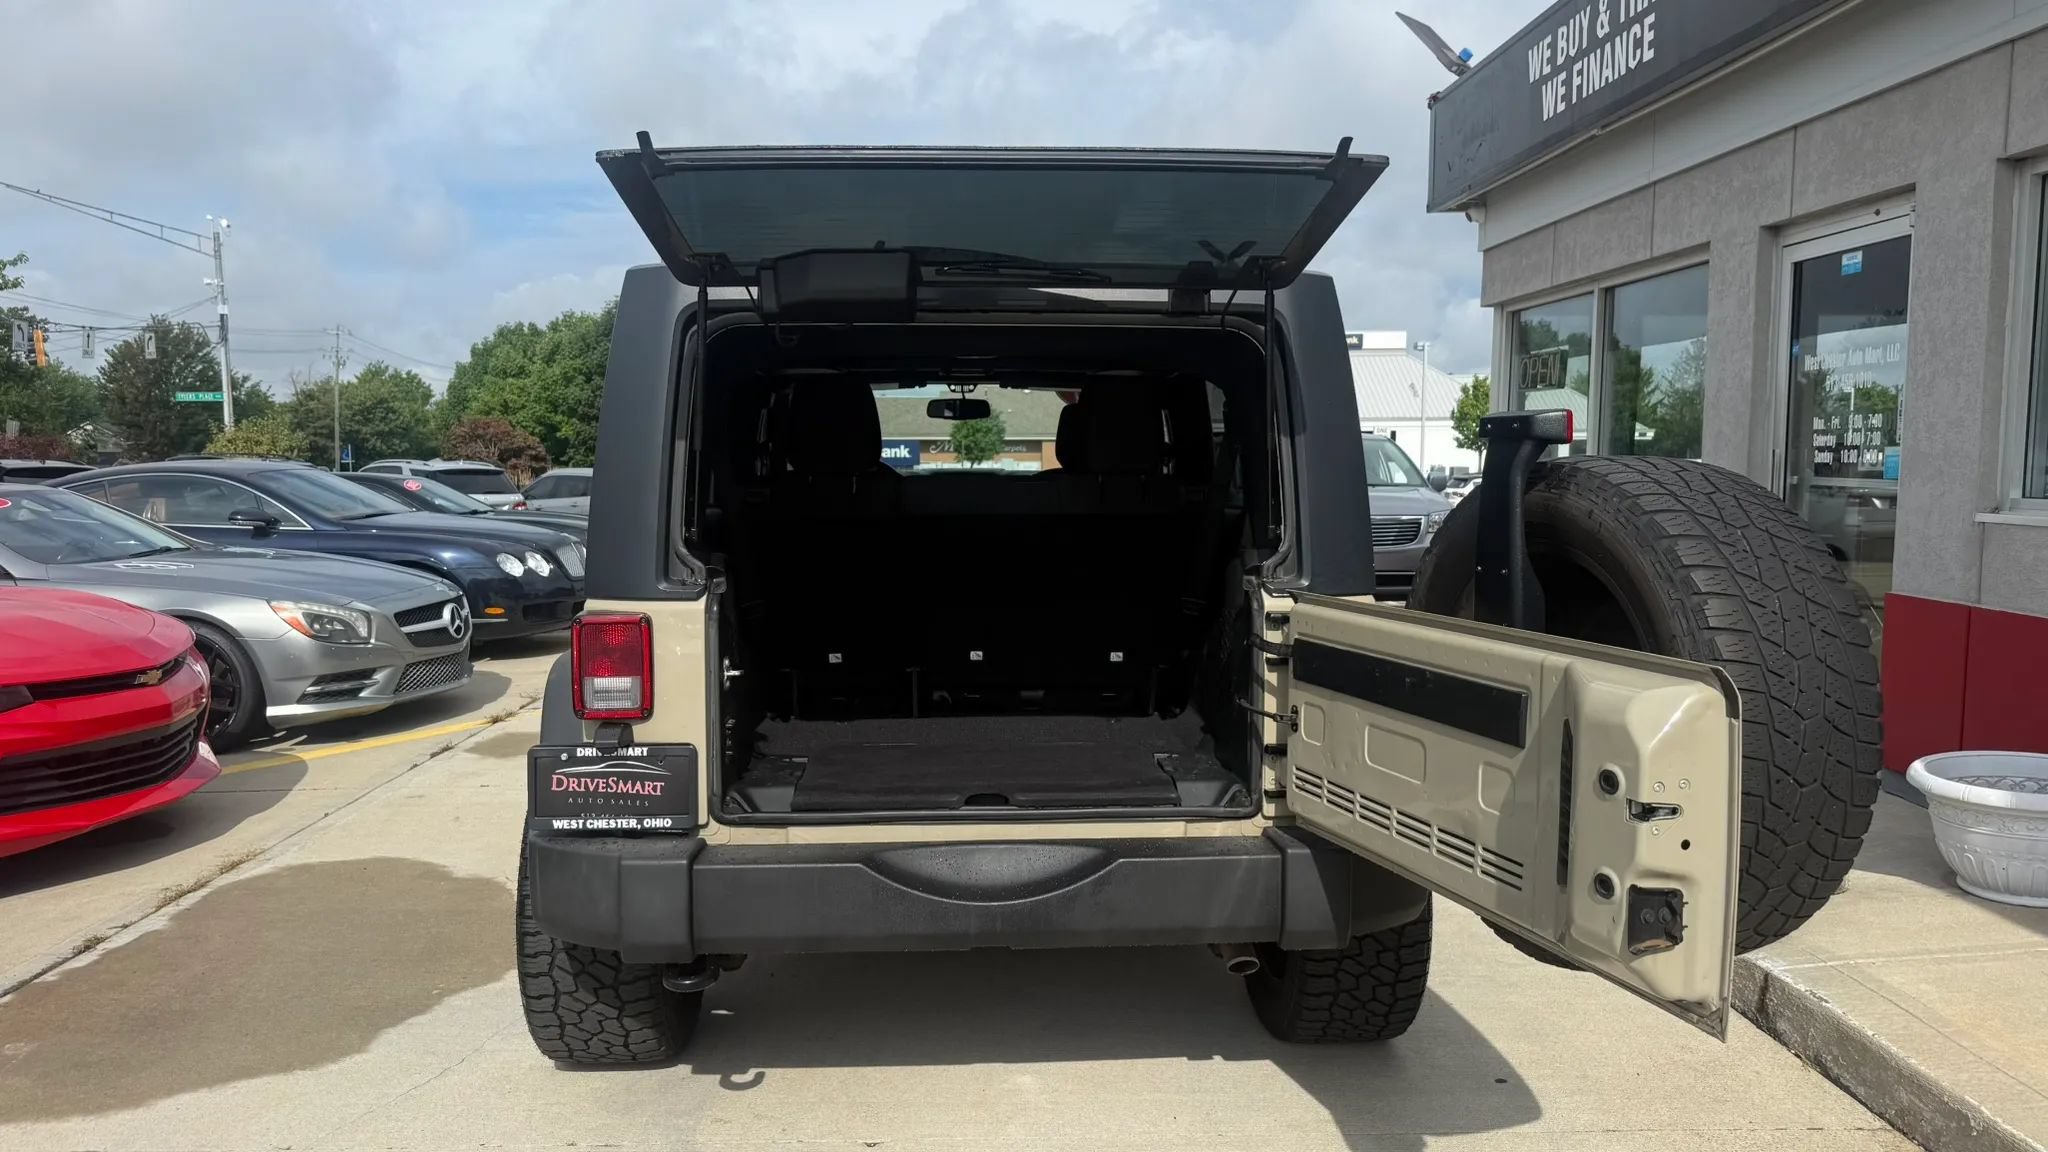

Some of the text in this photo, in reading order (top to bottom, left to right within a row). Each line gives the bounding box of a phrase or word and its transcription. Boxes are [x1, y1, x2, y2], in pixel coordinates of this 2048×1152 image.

[1528, 34, 1552, 84] WE
[1557, 5, 1591, 66] BUY
[1596, 0, 1610, 39] &
[1541, 13, 1655, 121] WE FINANCE
[1847, 347, 1864, 367] Auto
[1865, 345, 1884, 366] Mart,
[1887, 342, 1900, 362] LLC
[1520, 354, 1560, 388] OPEN
[1813, 417, 1826, 430] Mon.
[1831, 416, 1841, 429] Fri.
[1868, 413, 1883, 429] 7:00
[1812, 431, 1882, 448] Saturday 10:00 7:00
[881, 445, 910, 457] ank
[1814, 449, 1834, 464] Sunday
[1841, 449, 1858, 464] 10:00
[577, 748, 648, 757] DRIMART
[553, 818, 672, 830] WEST CHESTER, OHIO
